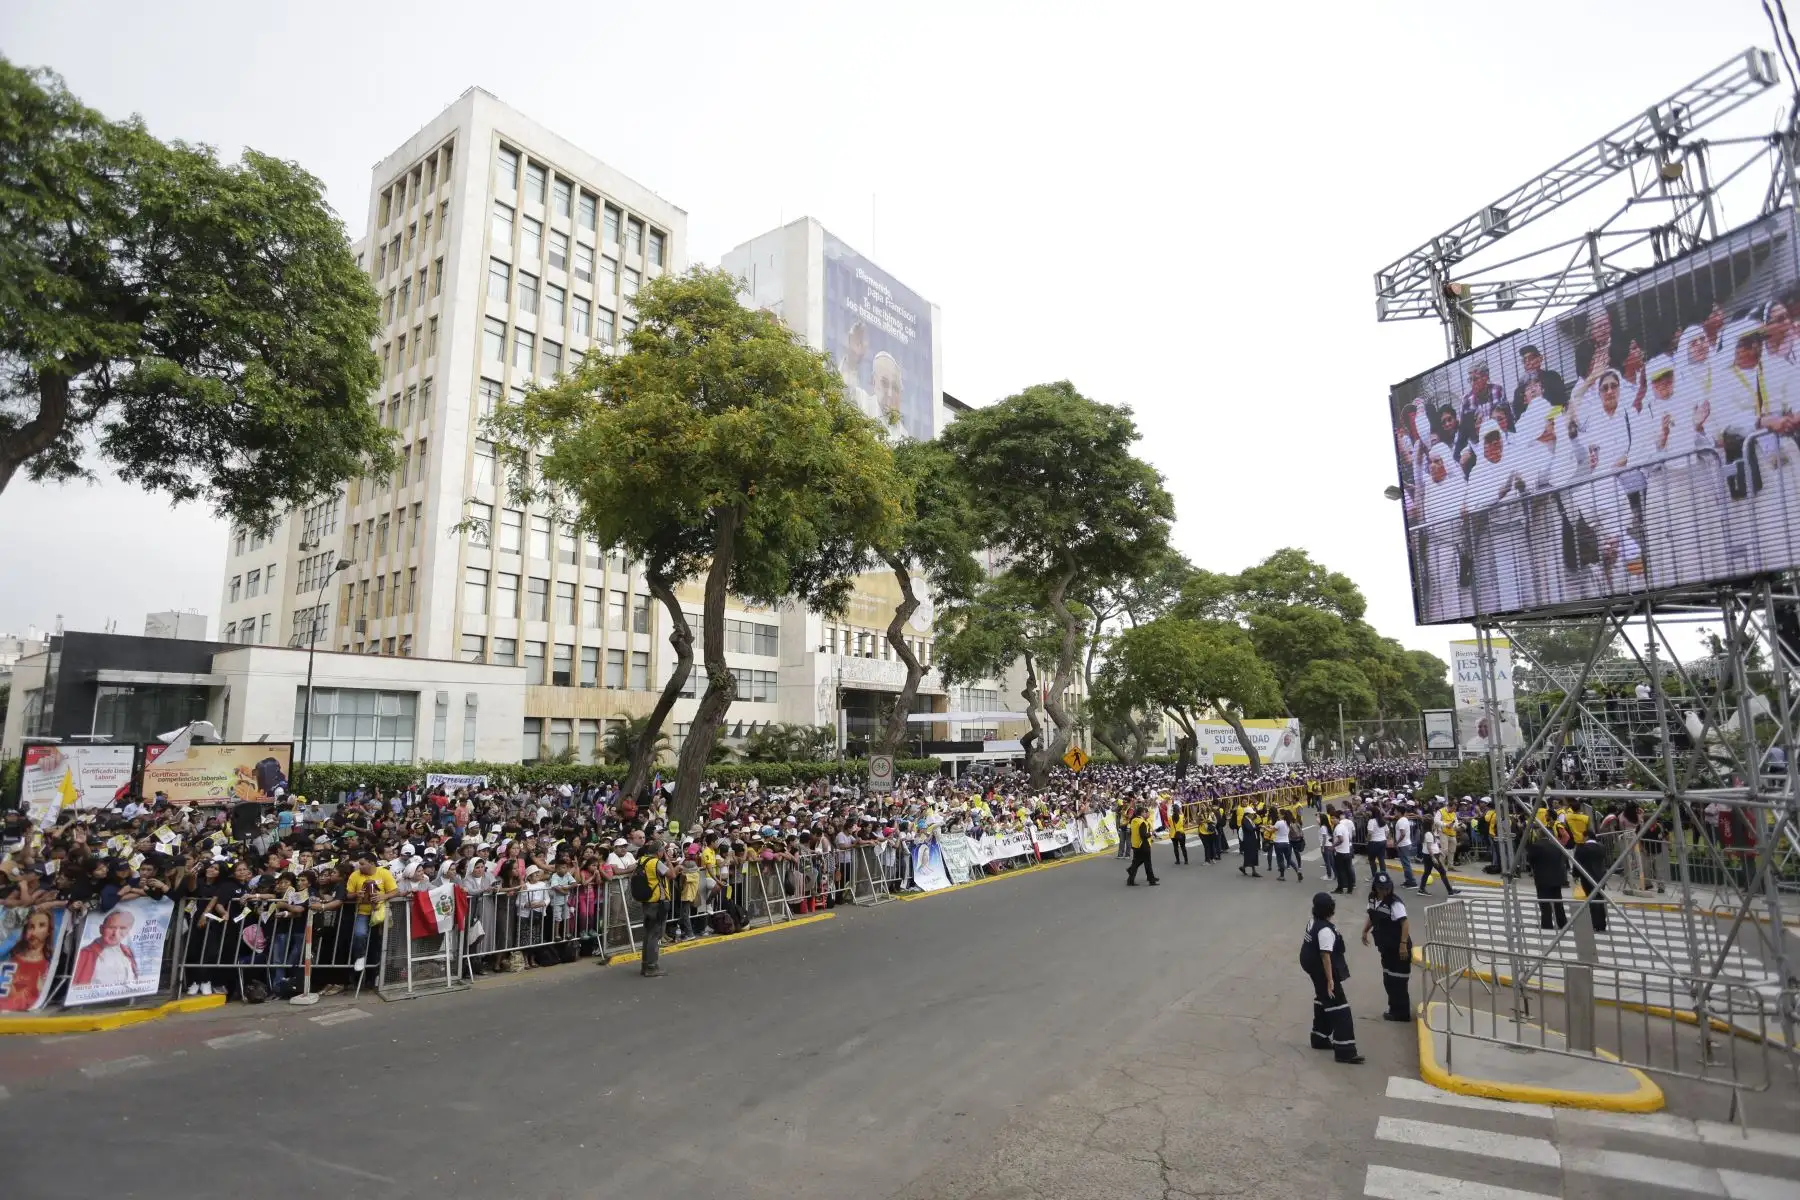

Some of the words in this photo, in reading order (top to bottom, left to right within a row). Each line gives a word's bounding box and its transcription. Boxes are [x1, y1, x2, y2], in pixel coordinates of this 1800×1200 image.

[867, 287, 884, 303] papa
[846, 296, 858, 312] los
[859, 304, 882, 326] brazos
[863, 296, 871, 310] Te
[872, 305, 904, 330] recibimos
[904, 326, 916, 339] con
[1214, 735, 1226, 744] SU
[1228, 734, 1270, 744] SAIDAD
[82, 767, 113, 775] Certificado
[157, 775, 200, 783] competencias
